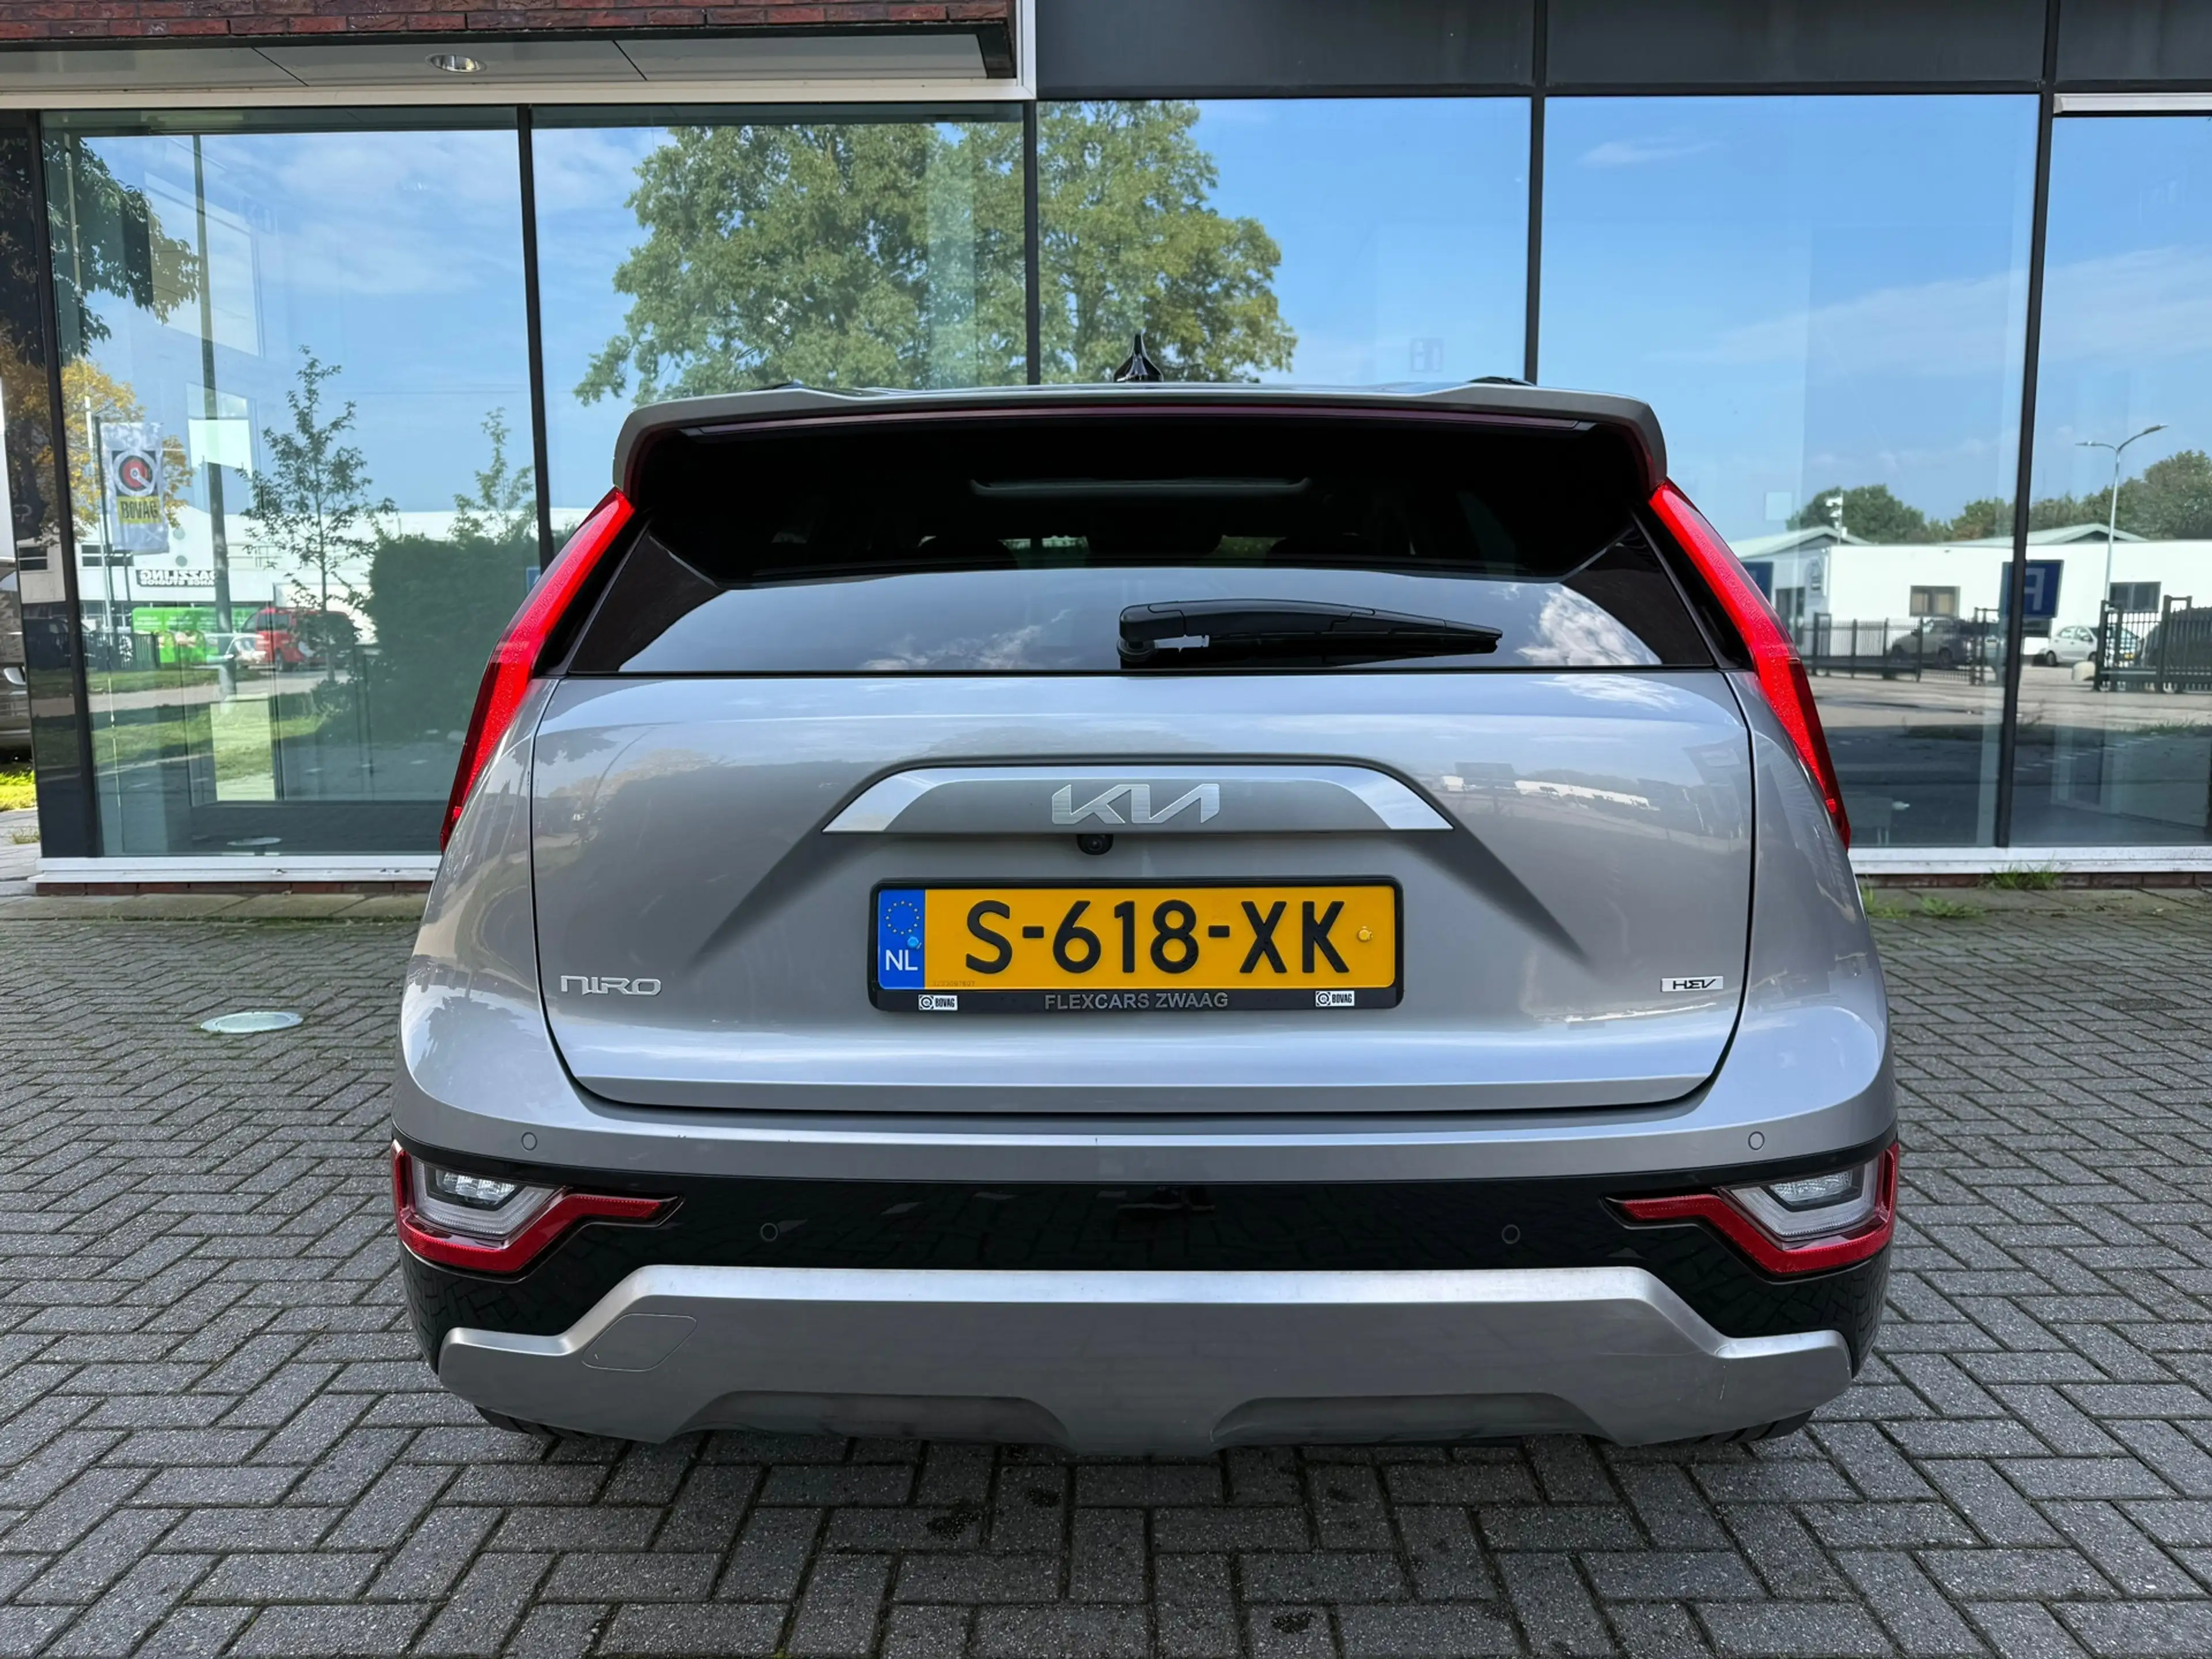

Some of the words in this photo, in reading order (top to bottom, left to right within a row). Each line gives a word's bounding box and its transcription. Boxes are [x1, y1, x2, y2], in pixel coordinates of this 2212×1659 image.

[120, 501, 159, 519] BOVAG
[1052, 783, 1220, 825] KIA
[965, 899, 1350, 975] S-618-XK
[885, 949, 918, 971] NL
[560, 975, 661, 996] NIRO
[1673, 978, 1717, 990] HEV
[935, 997, 955, 1007] BOVAG
[1044, 993, 1150, 1009] FLEXCARS
[1155, 992, 1229, 1008] ZWAAG
[1332, 994, 1353, 1003] BOVAG
